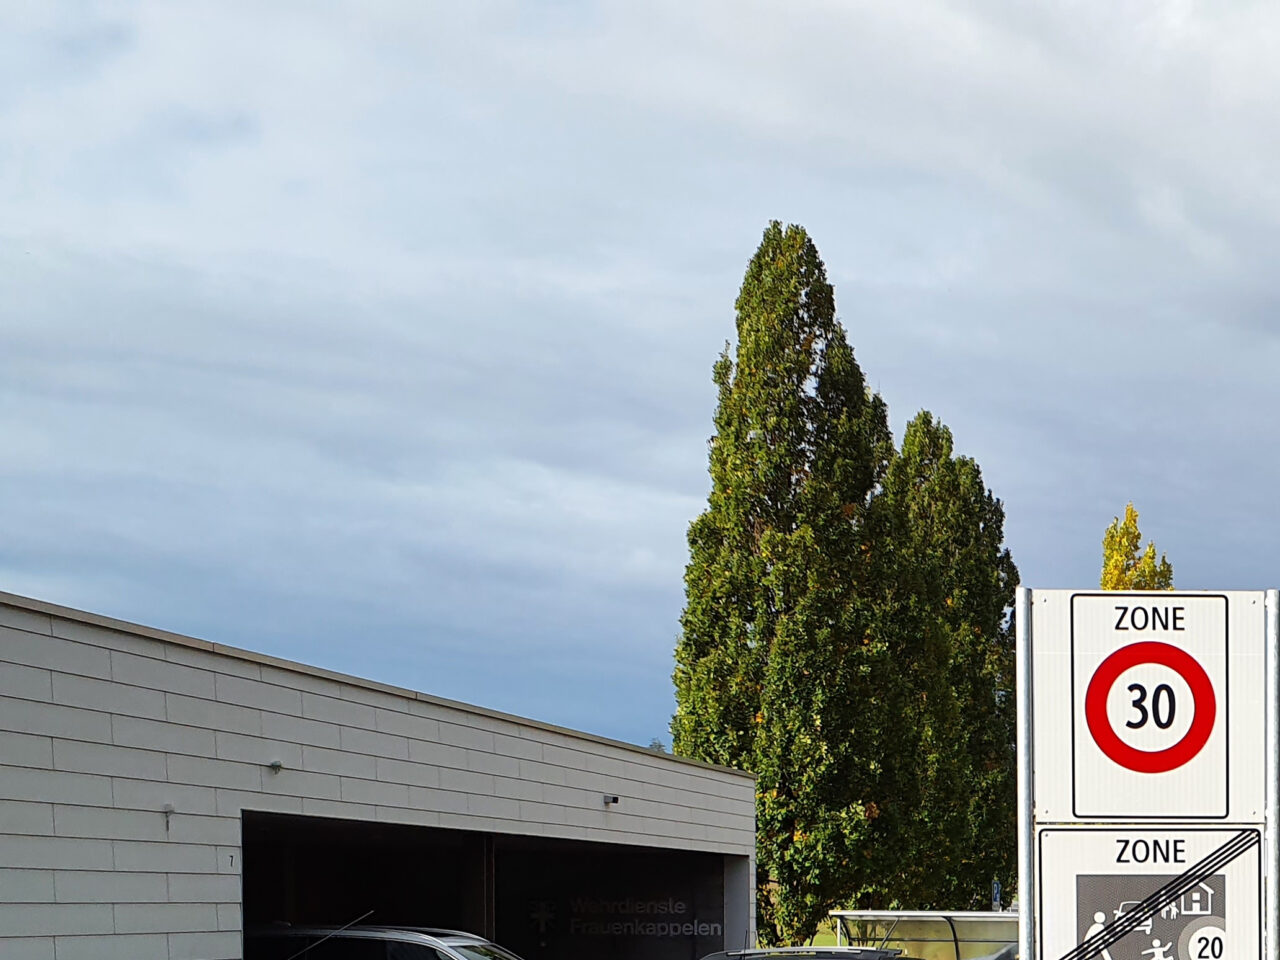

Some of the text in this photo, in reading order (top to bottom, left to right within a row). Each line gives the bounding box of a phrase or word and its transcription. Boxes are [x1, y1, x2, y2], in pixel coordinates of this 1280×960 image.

[1115, 606, 1185, 631] ZONE
[1126, 683, 1176, 730] 30
[1116, 839, 1186, 864] ZONE
[569, 897, 688, 915] Wehrdienste
[569, 919, 722, 937] Frauenkappelen
[1197, 936, 1224, 960] 20
